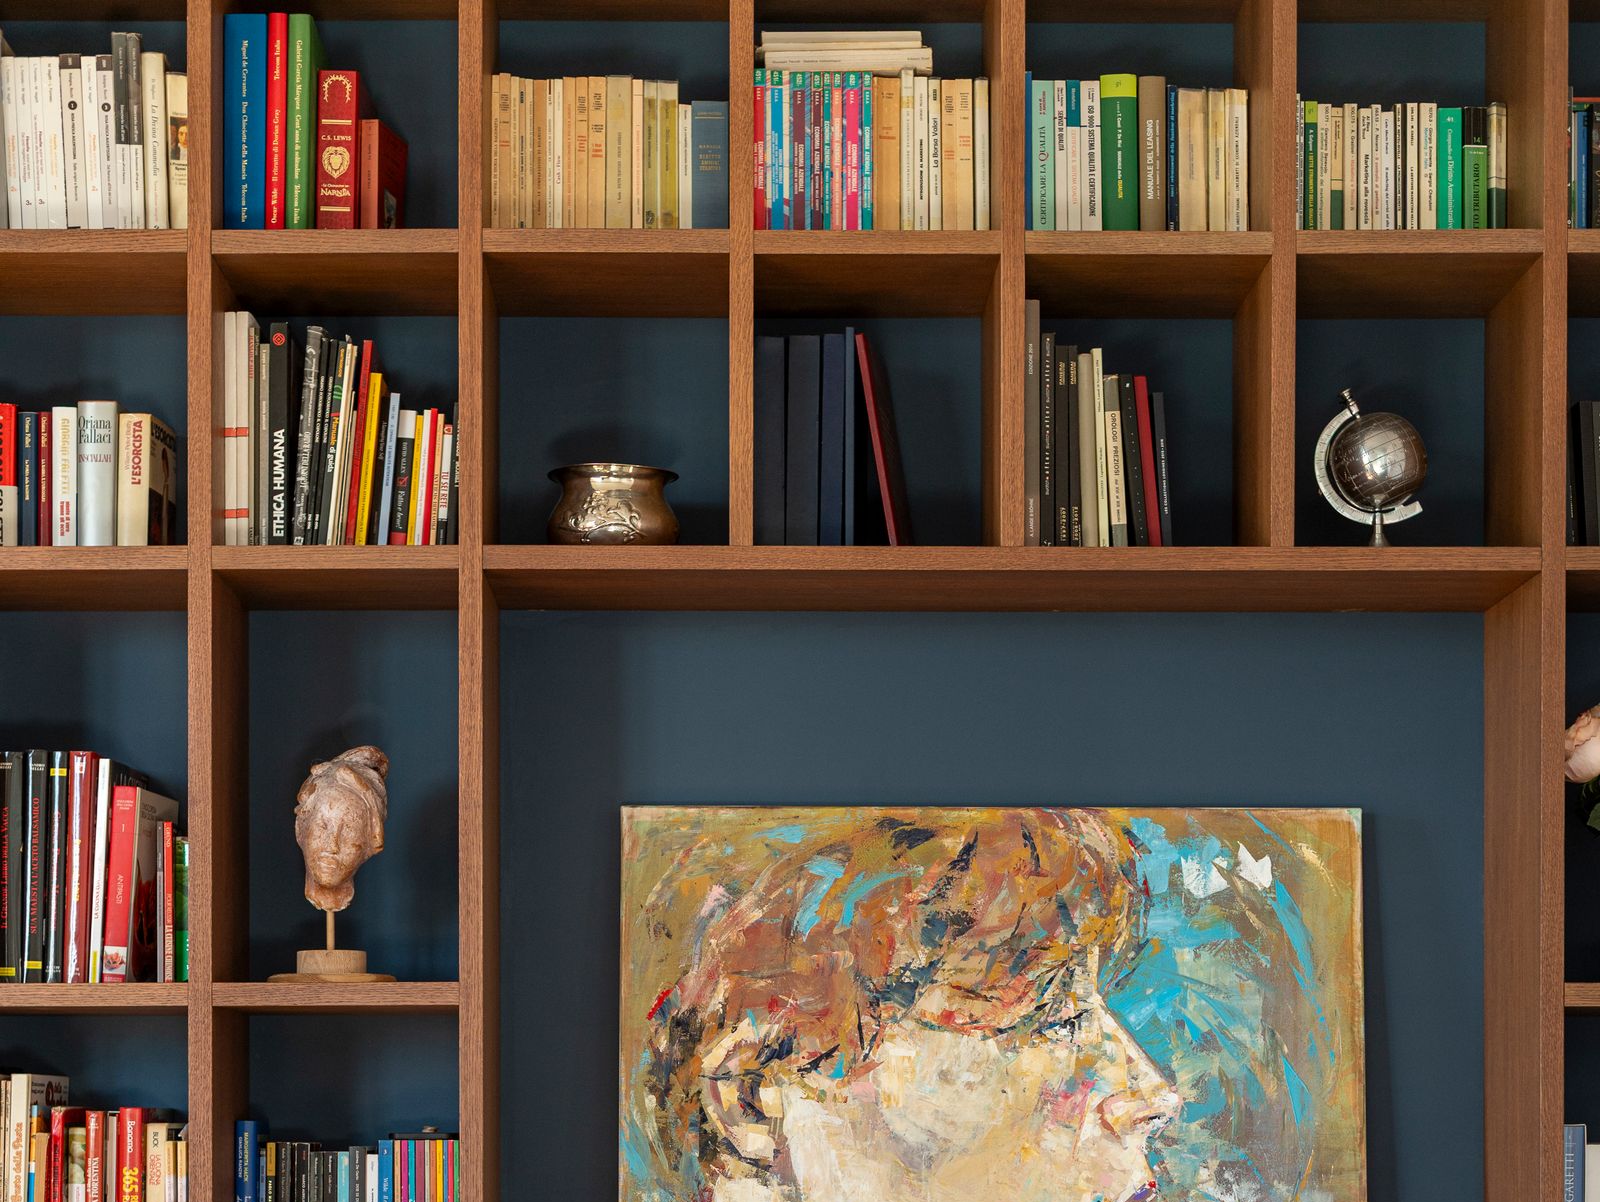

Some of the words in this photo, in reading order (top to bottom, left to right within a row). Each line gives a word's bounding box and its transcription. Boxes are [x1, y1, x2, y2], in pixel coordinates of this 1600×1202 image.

[241, 39, 249, 60] Miguel
[150, 116, 160, 138] Divina
[272, 109, 280, 124] Gray
[152, 139, 160, 177] Commedia
[1037, 125, 1049, 162] QUALITÀ
[1088, 151, 1096, 172] QUALITÀ
[320, 188, 351, 197] NARNIA
[1039, 174, 1047, 225] CERTIFICARE
[1088, 177, 1096, 217] CERTIFICAZIONE
[60, 418, 70, 455] GIORGIO
[78, 416, 111, 429] Oriana
[79, 429, 111, 444] Fallaci
[330, 416, 340, 445] Manuale
[1110, 412, 1118, 443] OROLOGI
[78, 454, 112, 463] INSCIALLAH
[131, 420, 143, 486] L'ESORCISTA
[272, 428, 285, 490] HUMANA
[327, 454, 336, 473] guida
[1112, 445, 1120, 476] PREZIOSI
[397, 490, 406, 507] Fatto
[439, 495, 448, 509] RETE
[440, 481, 449, 493] SEI
[272, 492, 285, 537] ETHICA
[31, 797, 40, 844] BALSAMICO
[31, 845, 39, 879] L'ACETO
[116, 874, 124, 905] ANTIPASTI
[91, 1157, 99, 1198] FIORENTINA
[122, 1166, 138, 1193] 365
